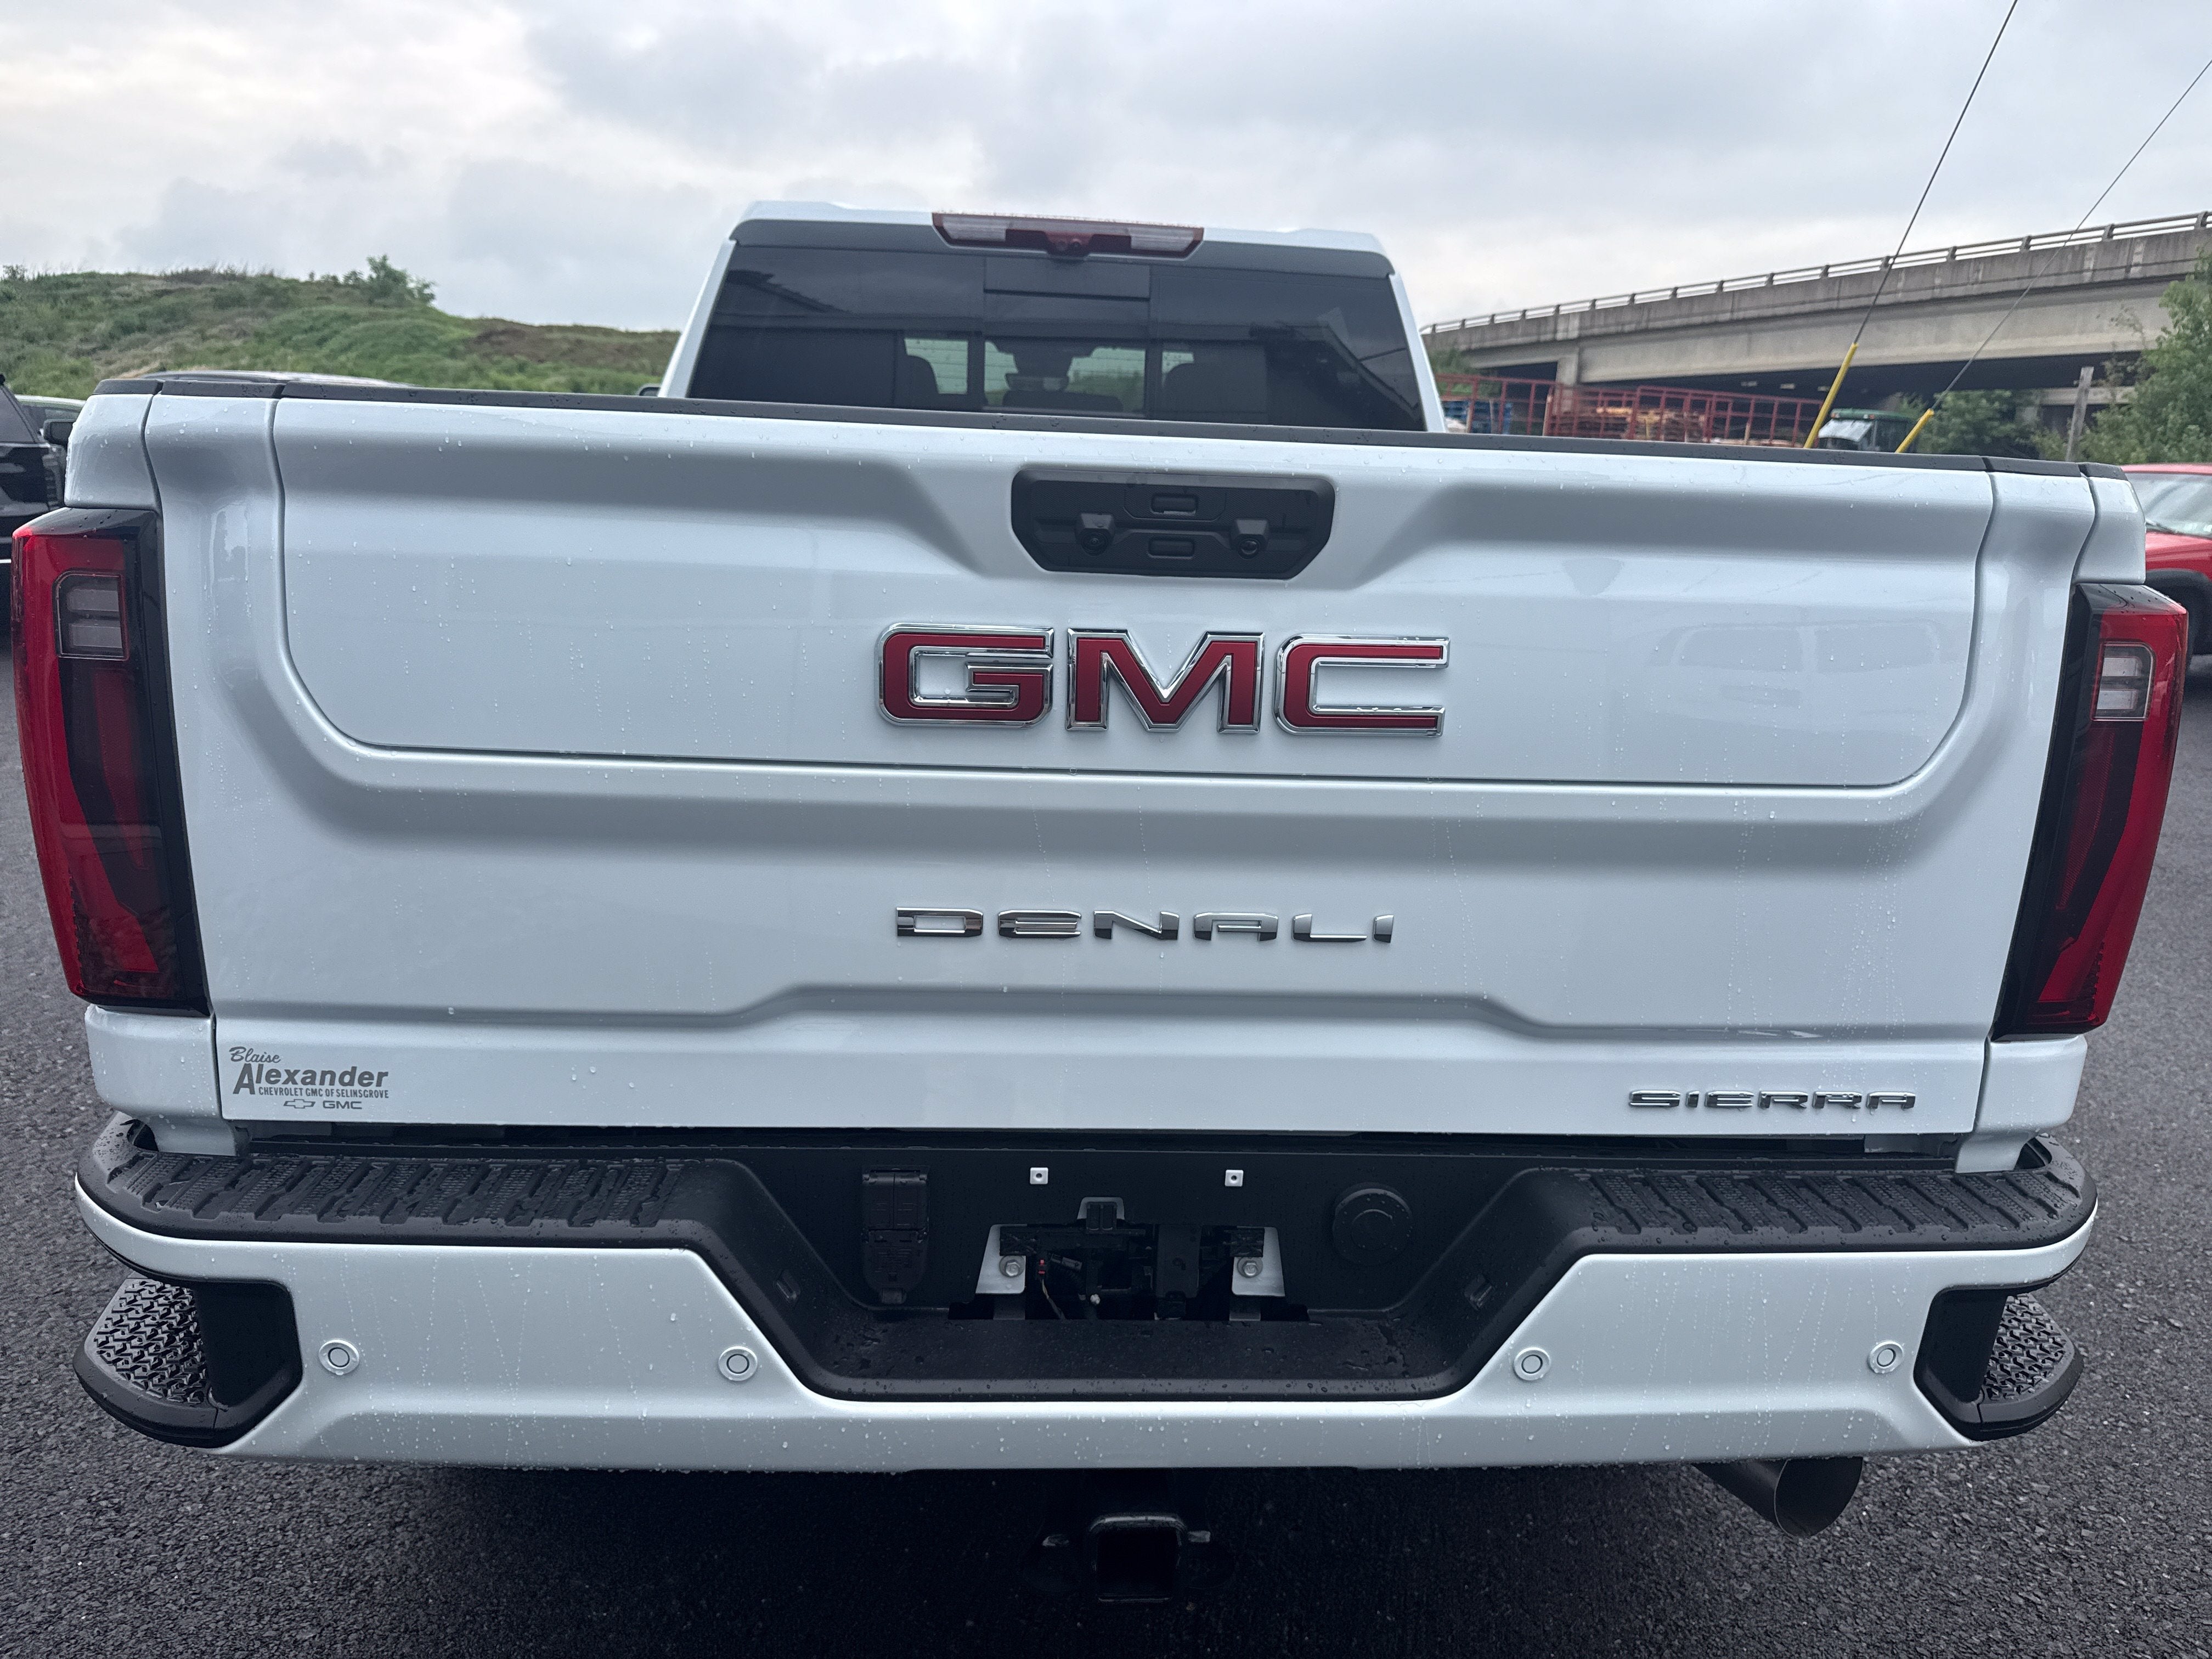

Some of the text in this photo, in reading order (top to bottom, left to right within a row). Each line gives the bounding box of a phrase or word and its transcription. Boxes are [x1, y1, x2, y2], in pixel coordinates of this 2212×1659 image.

[878, 622, 1451, 737] GMC
[896, 906, 1393, 943] DENALI
[229, 1046, 281, 1063] Blaise
[233, 1063, 389, 1095] Alexander
[258, 1087, 389, 1098] CHEVROLET GMC OF SELINSGROVE
[1629, 1090, 1916, 1110] SIERRA
[323, 1100, 363, 1110] GMC
